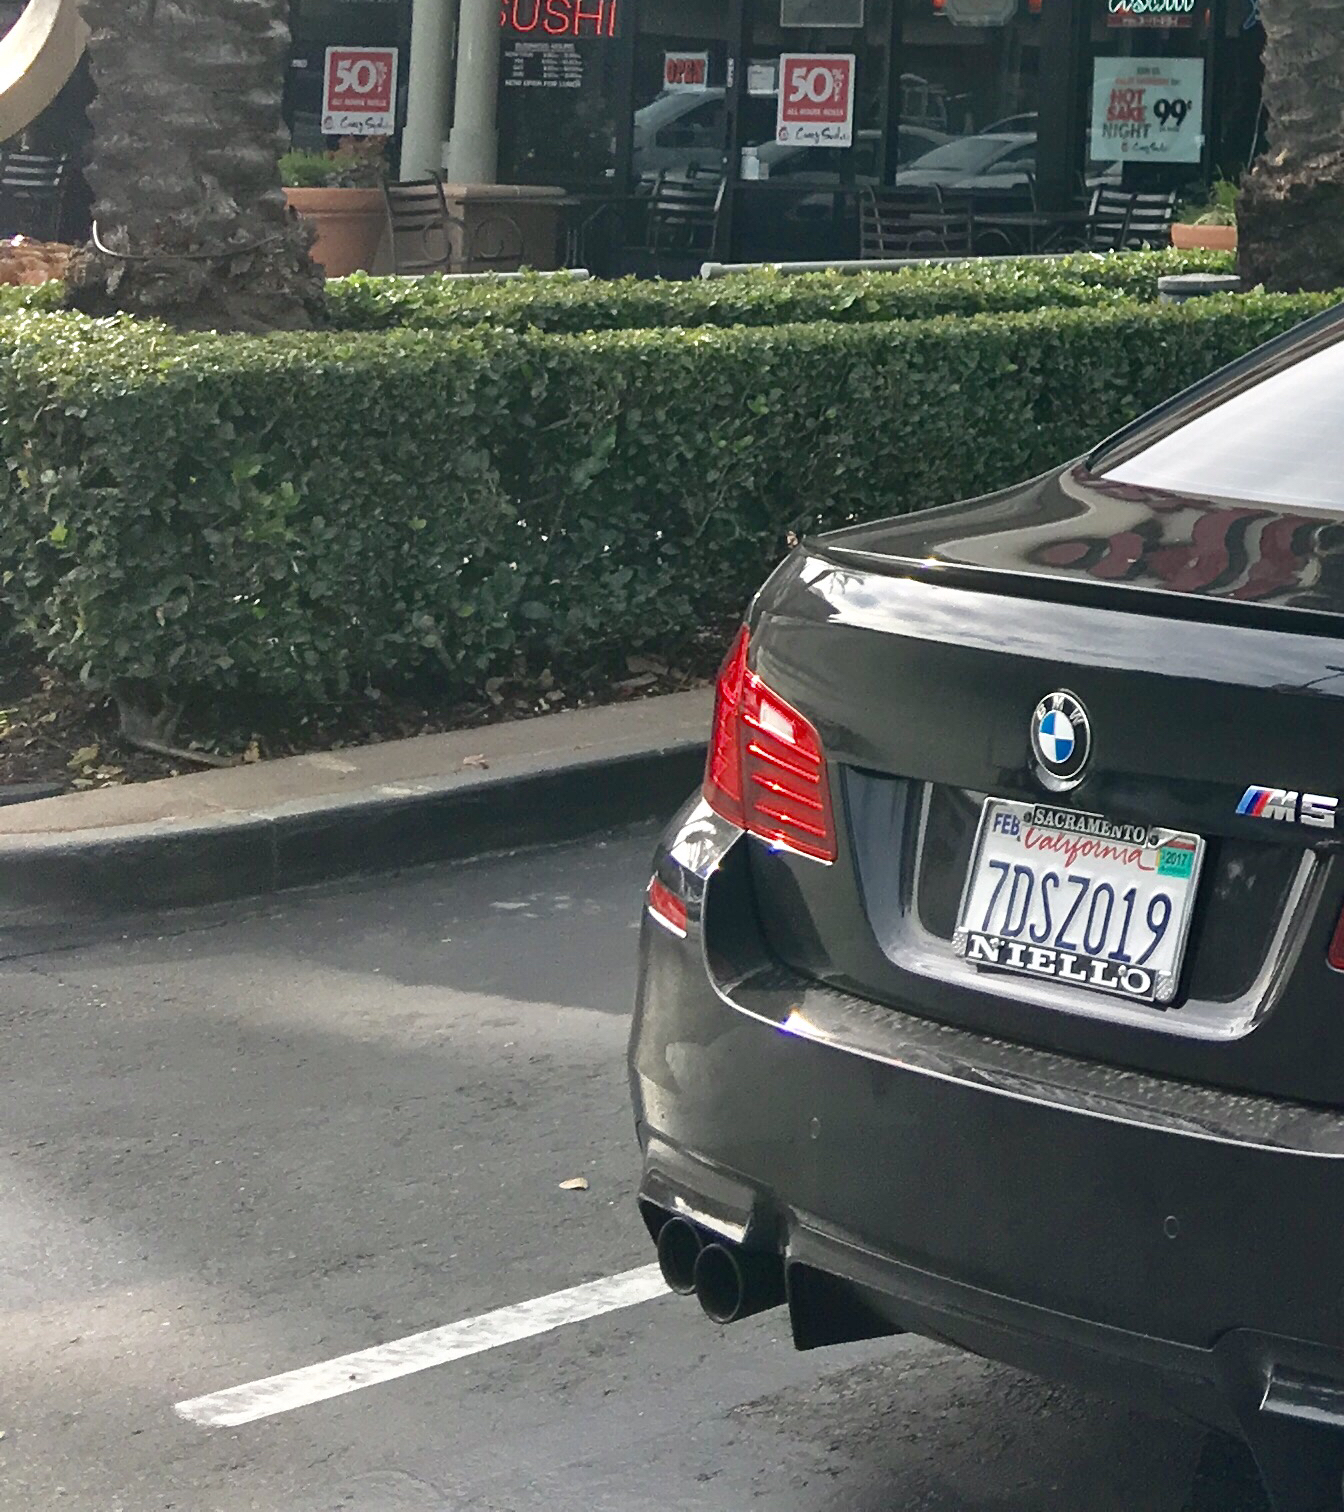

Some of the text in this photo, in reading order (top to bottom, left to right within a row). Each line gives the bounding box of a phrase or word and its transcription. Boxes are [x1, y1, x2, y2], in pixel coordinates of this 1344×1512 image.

[1110, 89, 1146, 105] HOT
[1101, 123, 1152, 139] NIGHT
[1107, 106, 1148, 123] SAKE
[1036, 694, 1085, 727] BMW
[1236, 784, 1339, 829] M5
[992, 812, 1021, 838] FEB
[1034, 808, 1147, 844] SACRAMENTO
[1024, 826, 1155, 869] California
[1165, 851, 1189, 867] 2017
[981, 859, 1173, 966] 7DSZ019
[968, 934, 1151, 994] NIELLO
